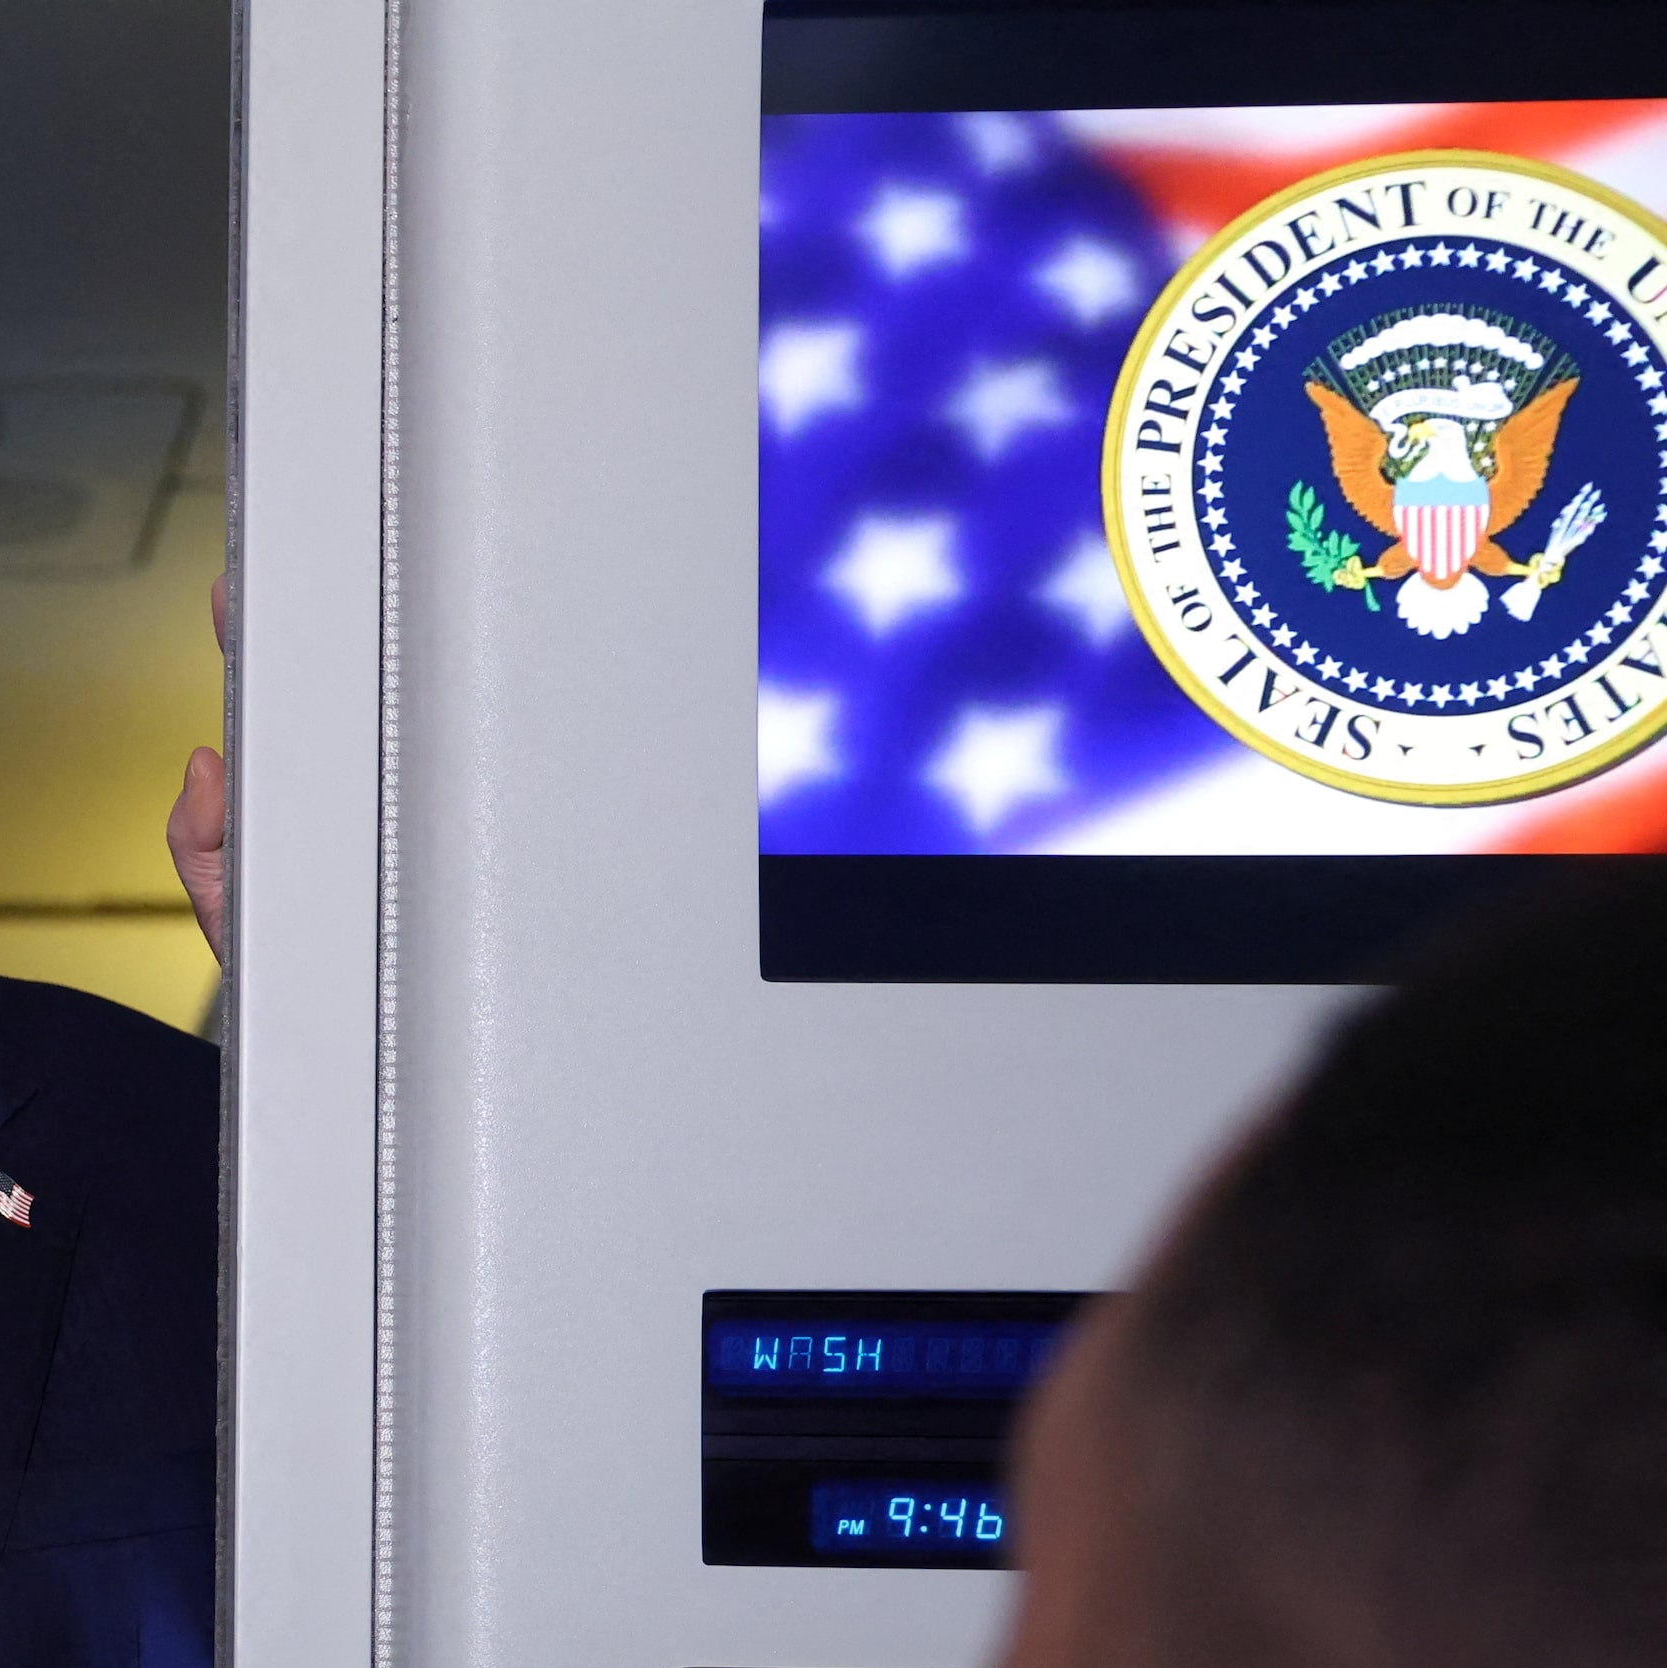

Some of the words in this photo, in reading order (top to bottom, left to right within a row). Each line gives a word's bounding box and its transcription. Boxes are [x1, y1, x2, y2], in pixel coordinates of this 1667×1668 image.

[1447, 186, 1510, 219] OF
[1529, 197, 1616, 260] THE
[1136, 180, 1426, 455] PRESIDENT
[1141, 474, 1182, 563] THE
[1166, 583, 1213, 632] OF
[1217, 633, 1381, 761] SEAL
[1507, 614, 1667, 760] ATES
[753, 1336, 882, 1373] WASH
[837, 1519, 865, 1535] PM
[887, 1497, 1003, 1540] 9:46
